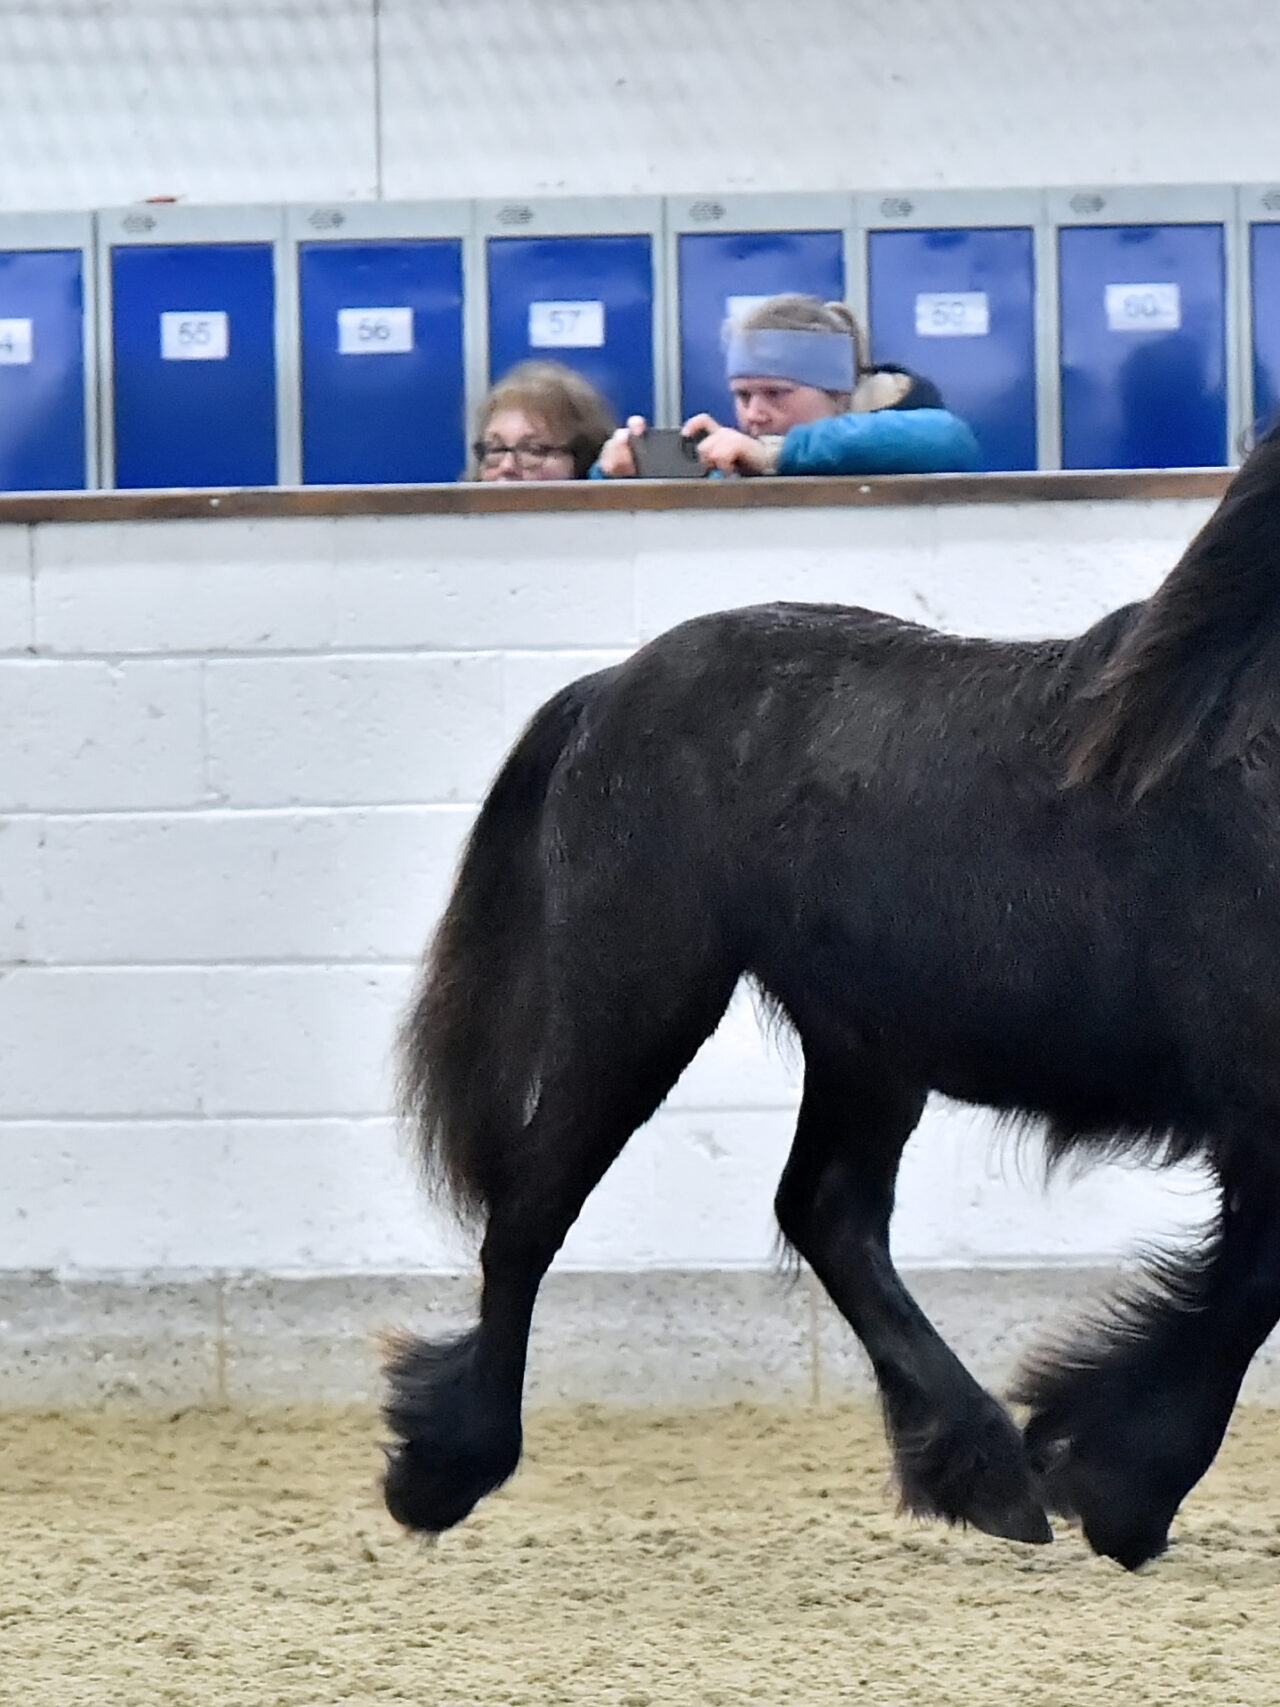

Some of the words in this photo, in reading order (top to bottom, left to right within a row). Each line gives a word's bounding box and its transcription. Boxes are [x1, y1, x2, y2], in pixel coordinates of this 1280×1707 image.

[178, 321, 212, 346] 55
[358, 317, 391, 342] 56
[550, 311, 581, 336] 57
